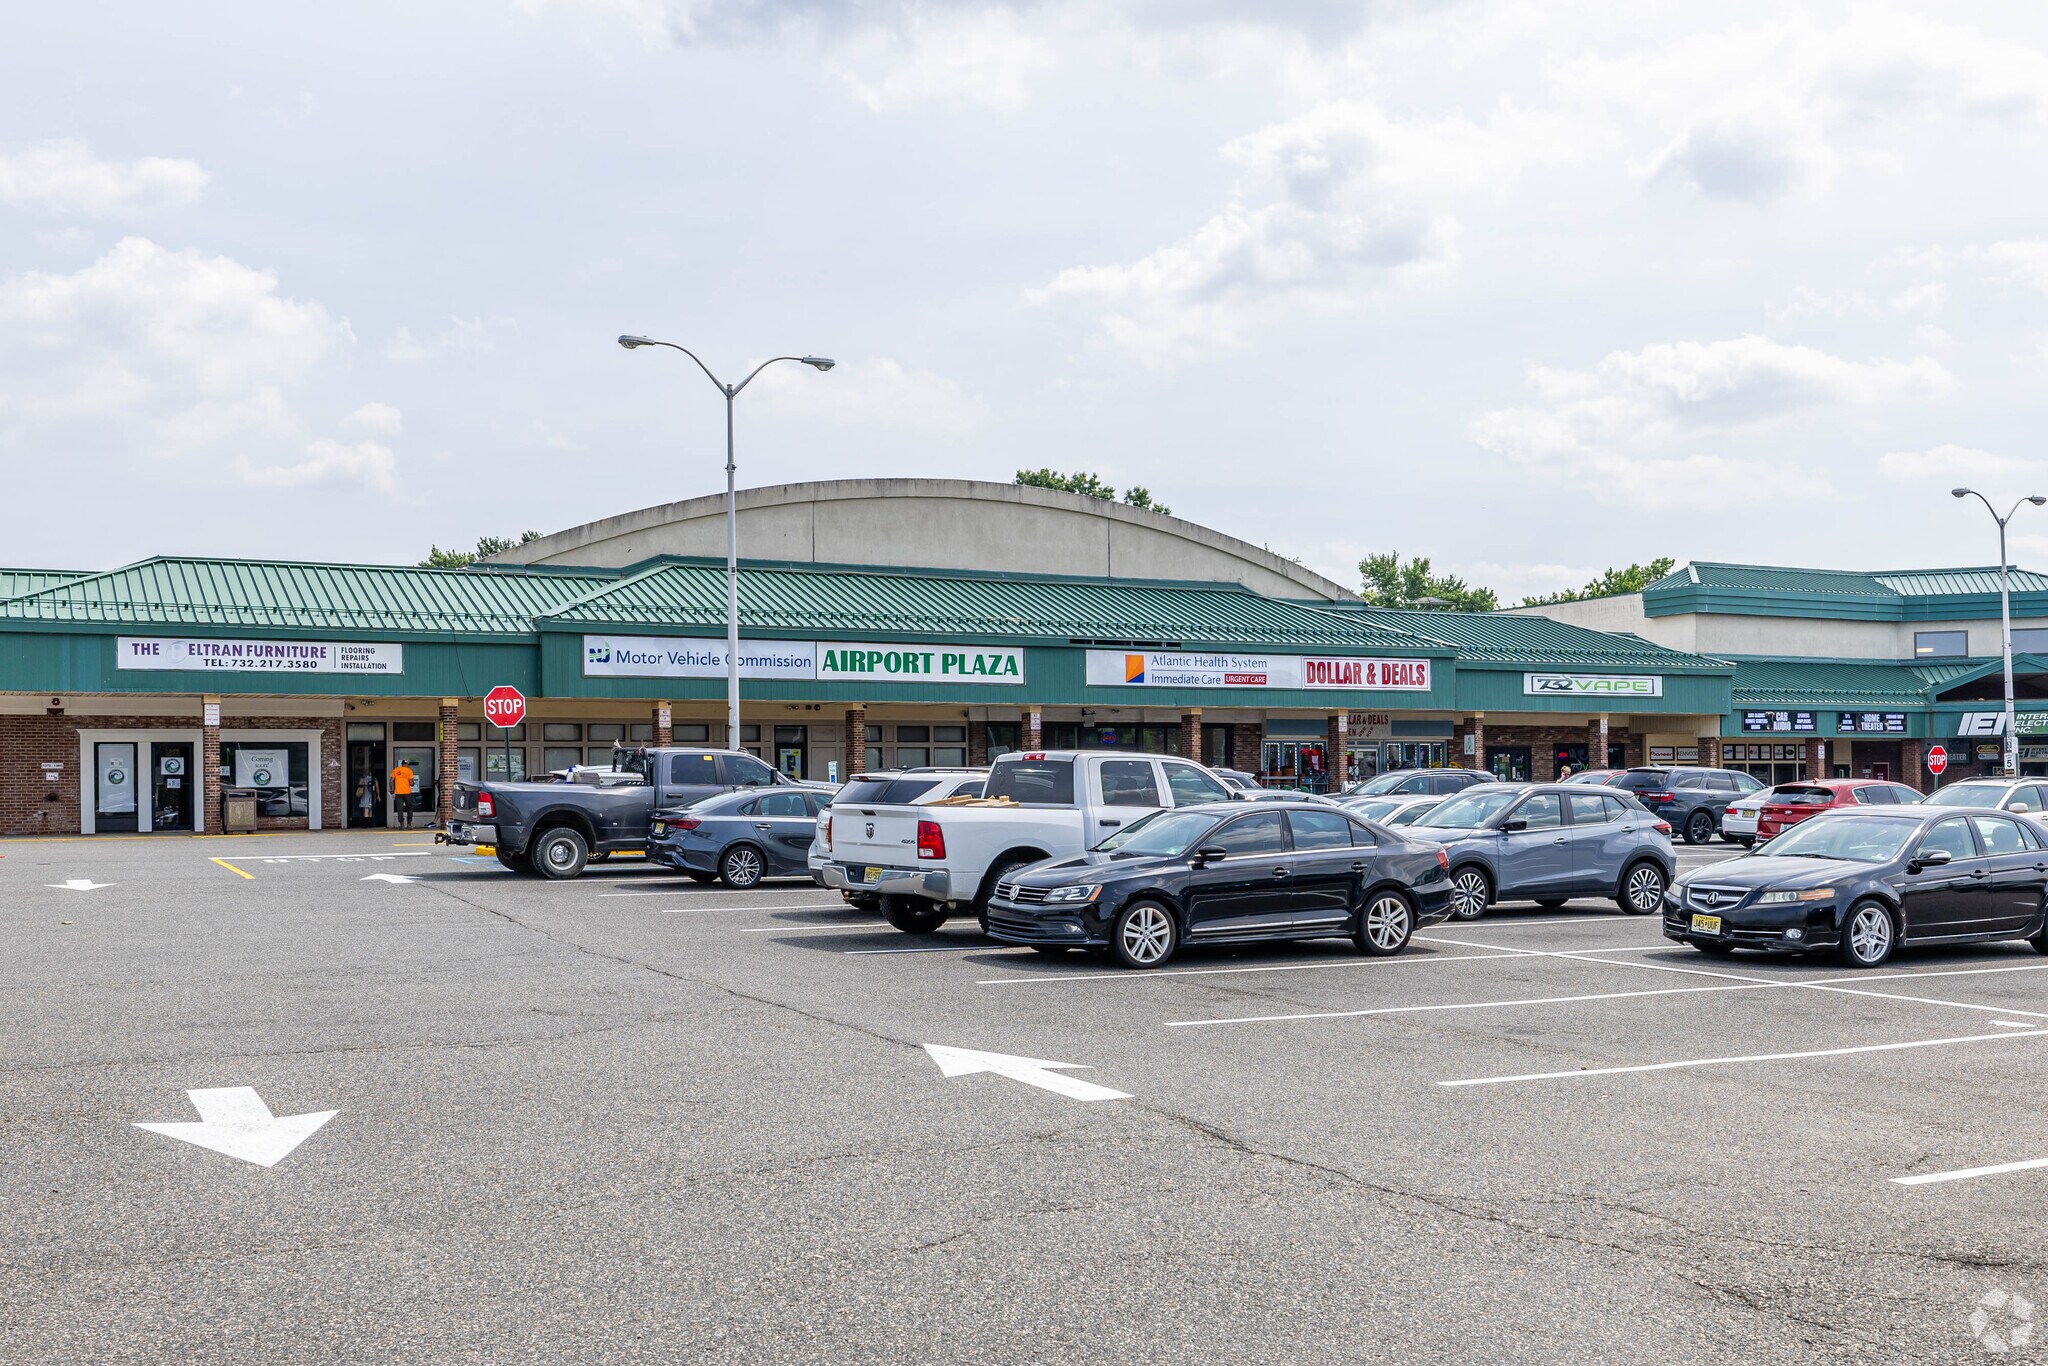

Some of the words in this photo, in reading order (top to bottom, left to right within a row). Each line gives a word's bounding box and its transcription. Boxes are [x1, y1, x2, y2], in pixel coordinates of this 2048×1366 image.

[132, 643, 160, 655] THE
[246, 645, 327, 659] FURNITURE
[203, 658, 228, 667] TEL:
[231, 659, 317, 668] 732.217.3580
[616, 650, 663, 665] Motor
[667, 651, 720, 666] Vehicle
[725, 653, 811, 668] ommission
[822, 649, 935, 674] AIRPORT
[942, 653, 1019, 676] PLAZA
[1151, 655, 1191, 667] Atlantic
[1194, 656, 1228, 668] Health
[1231, 657, 1267, 670] System
[341, 662, 387, 670] INSTALLATION
[1151, 673, 1199, 684] Immediate
[1201, 675, 1221, 685] Care
[1225, 675, 1249, 683] URGENT
[1306, 661, 1362, 685] DOLLAR
[1366, 662, 1377, 685] &
[1381, 663, 1425, 686] DEALS
[1575, 679, 1648, 692] VAPE
[487, 698, 522, 715] STOP
[1368, 714, 1389, 725] DEALS
[1775, 711, 1788, 722] CAR
[1773, 721, 1791, 731] AUDIO
[1861, 721, 1884, 731] THEATER
[2014, 719, 2048, 727] ELECT
[2014, 726, 2033, 734] NC.
[1929, 754, 1946, 766] STOP
[2006, 759, 2013, 768] 5
